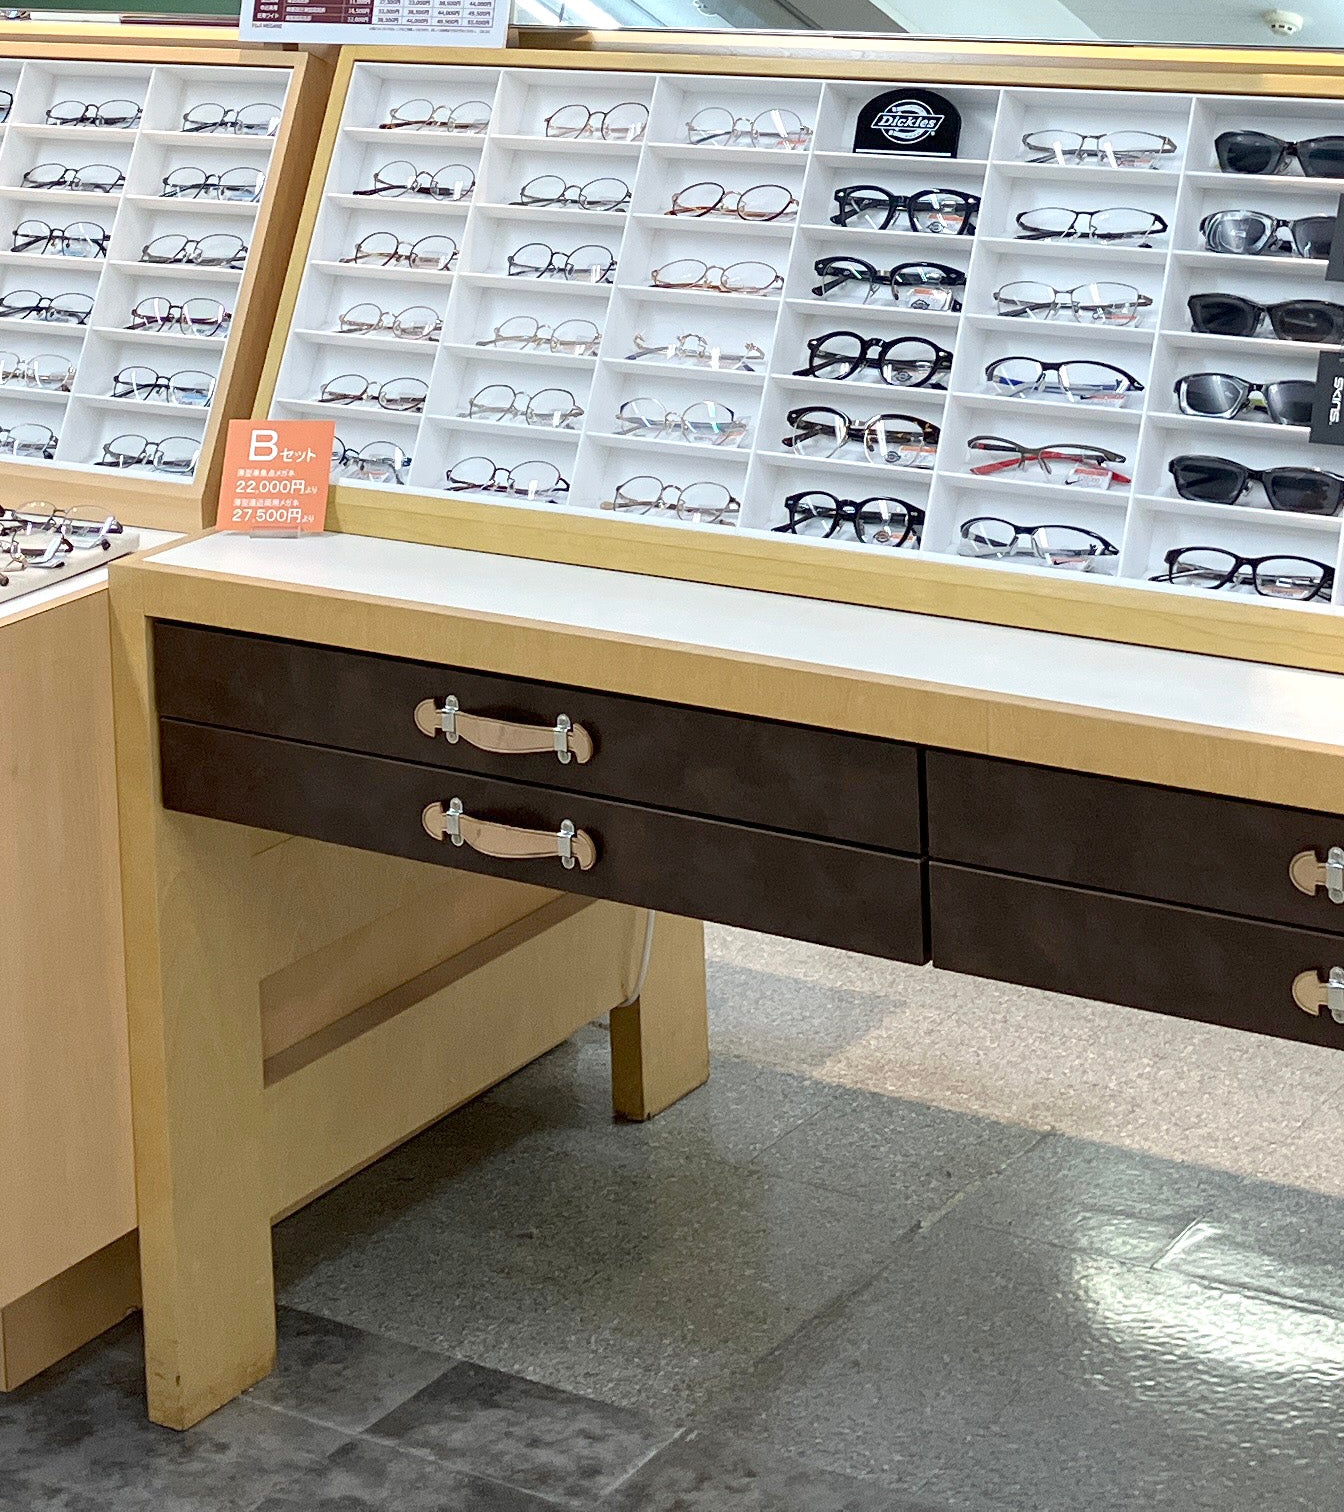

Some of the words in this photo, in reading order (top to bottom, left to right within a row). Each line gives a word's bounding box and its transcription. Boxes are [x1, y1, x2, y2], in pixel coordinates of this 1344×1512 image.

[877, 115, 937, 128] Dickies
[248, 429, 317, 463] Bセット
[235, 479, 318, 495] 22,000円より
[232, 508, 315, 524] 27,500円より
